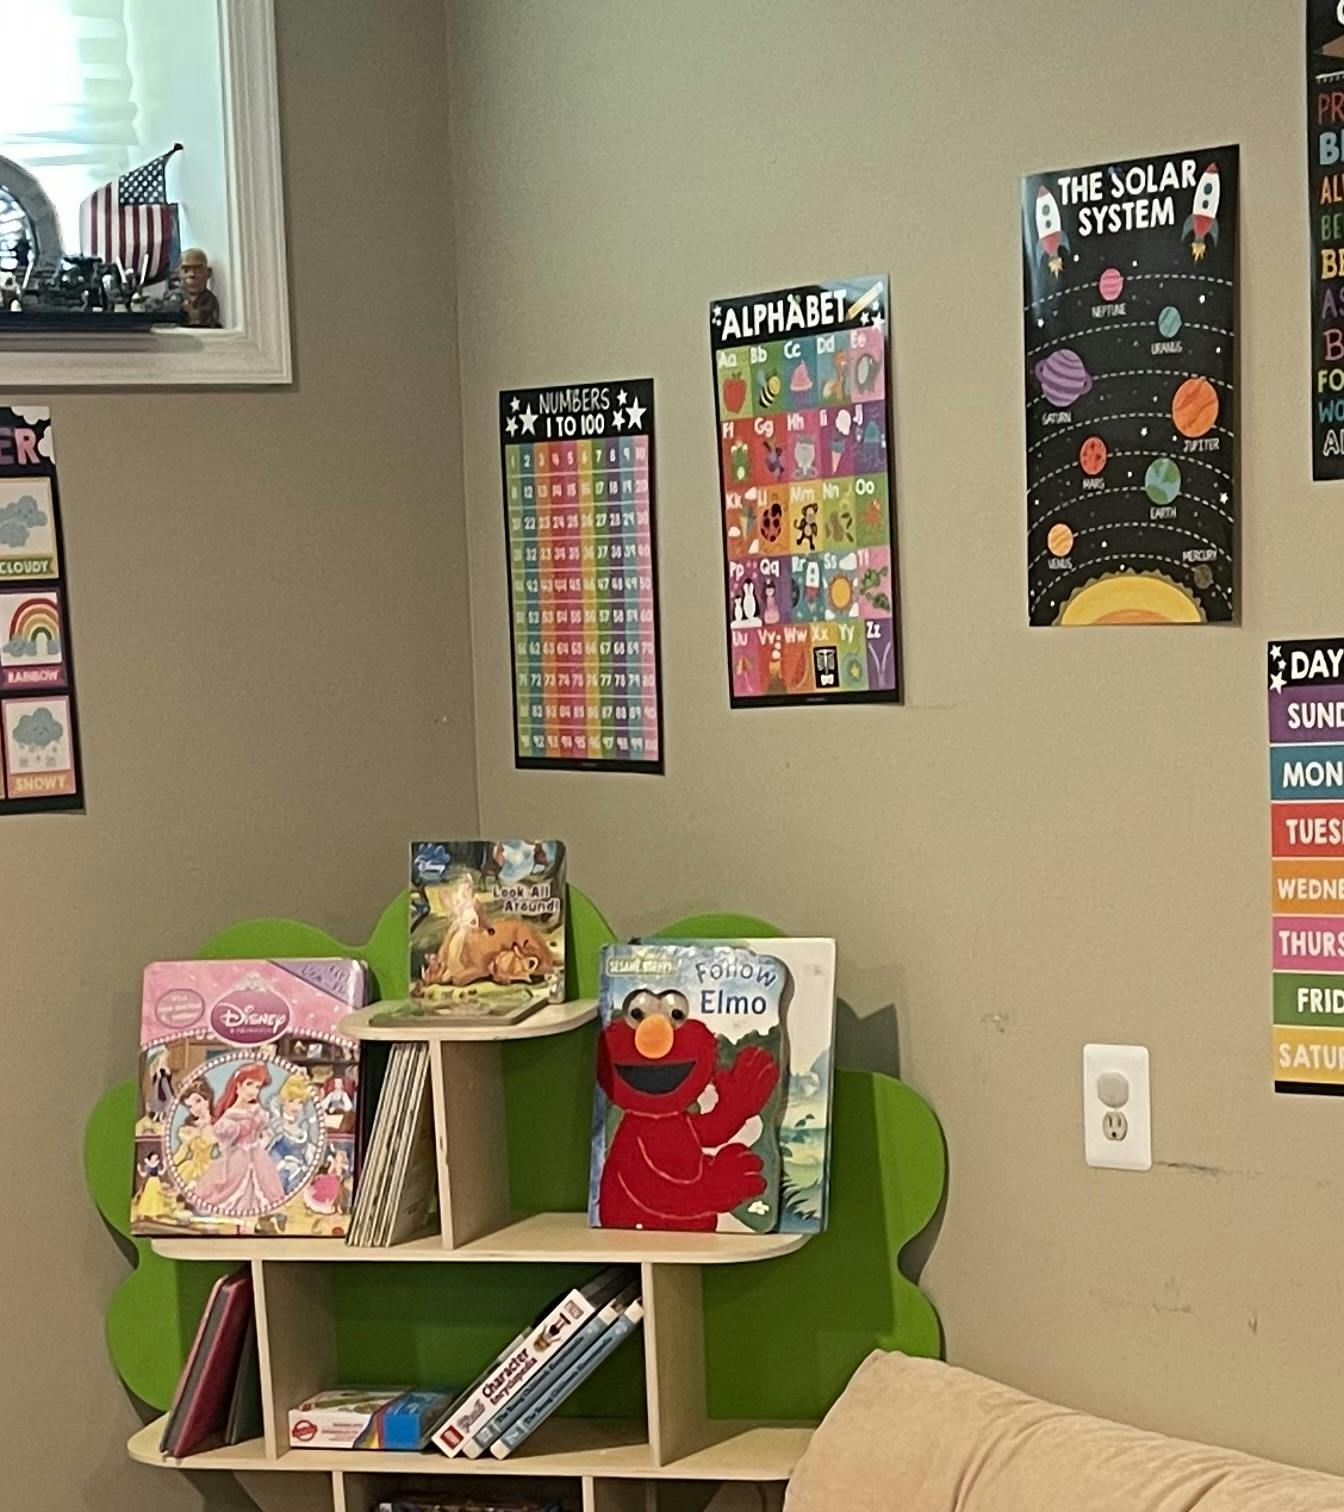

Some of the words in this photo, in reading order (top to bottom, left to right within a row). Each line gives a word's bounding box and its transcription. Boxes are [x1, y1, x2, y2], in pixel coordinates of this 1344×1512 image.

[1057, 171, 1103, 206] THE
[1111, 159, 1197, 199] SOLAR
[1078, 196, 1175, 237] SYSTEM
[721, 289, 847, 341] ALPHABET
[718, 352, 737, 369] Aa
[750, 347, 767, 364] Bb
[784, 341, 801, 359] Cc
[817, 335, 835, 355] Dd
[850, 331, 866, 349] Ee
[539, 387, 610, 415] NUMBERS
[556, 415, 577, 437] TO
[581, 413, 605, 436] 100
[754, 418, 774, 437] Gg
[787, 414, 804, 431] Hh
[1182, 437, 1220, 453] JUPITER
[822, 482, 840, 499] Nn
[855, 479, 875, 496] Oo
[1082, 478, 1105, 490] MARS
[1150, 506, 1177, 520] EARTH
[730, 561, 744, 579] Pp
[760, 559, 779, 577] Qq
[824, 553, 838, 570] Ss
[1047, 557, 1073, 570] VENUS
[1182, 548, 1217, 562] MERCURY
[783, 628, 807, 643] Ww
[838, 624, 855, 642] Yy
[866, 621, 882, 638] Zz
[8, 670, 58, 683] RAINBOW
[15, 776, 66, 791] SNOWY
[492, 886, 523, 899] Look
[531, 885, 551, 898] All
[504, 901, 555, 914] Around
[701, 989, 767, 1015] Elmo
[216, 1002, 286, 1034] Disney
[482, 1348, 529, 1399] Character
